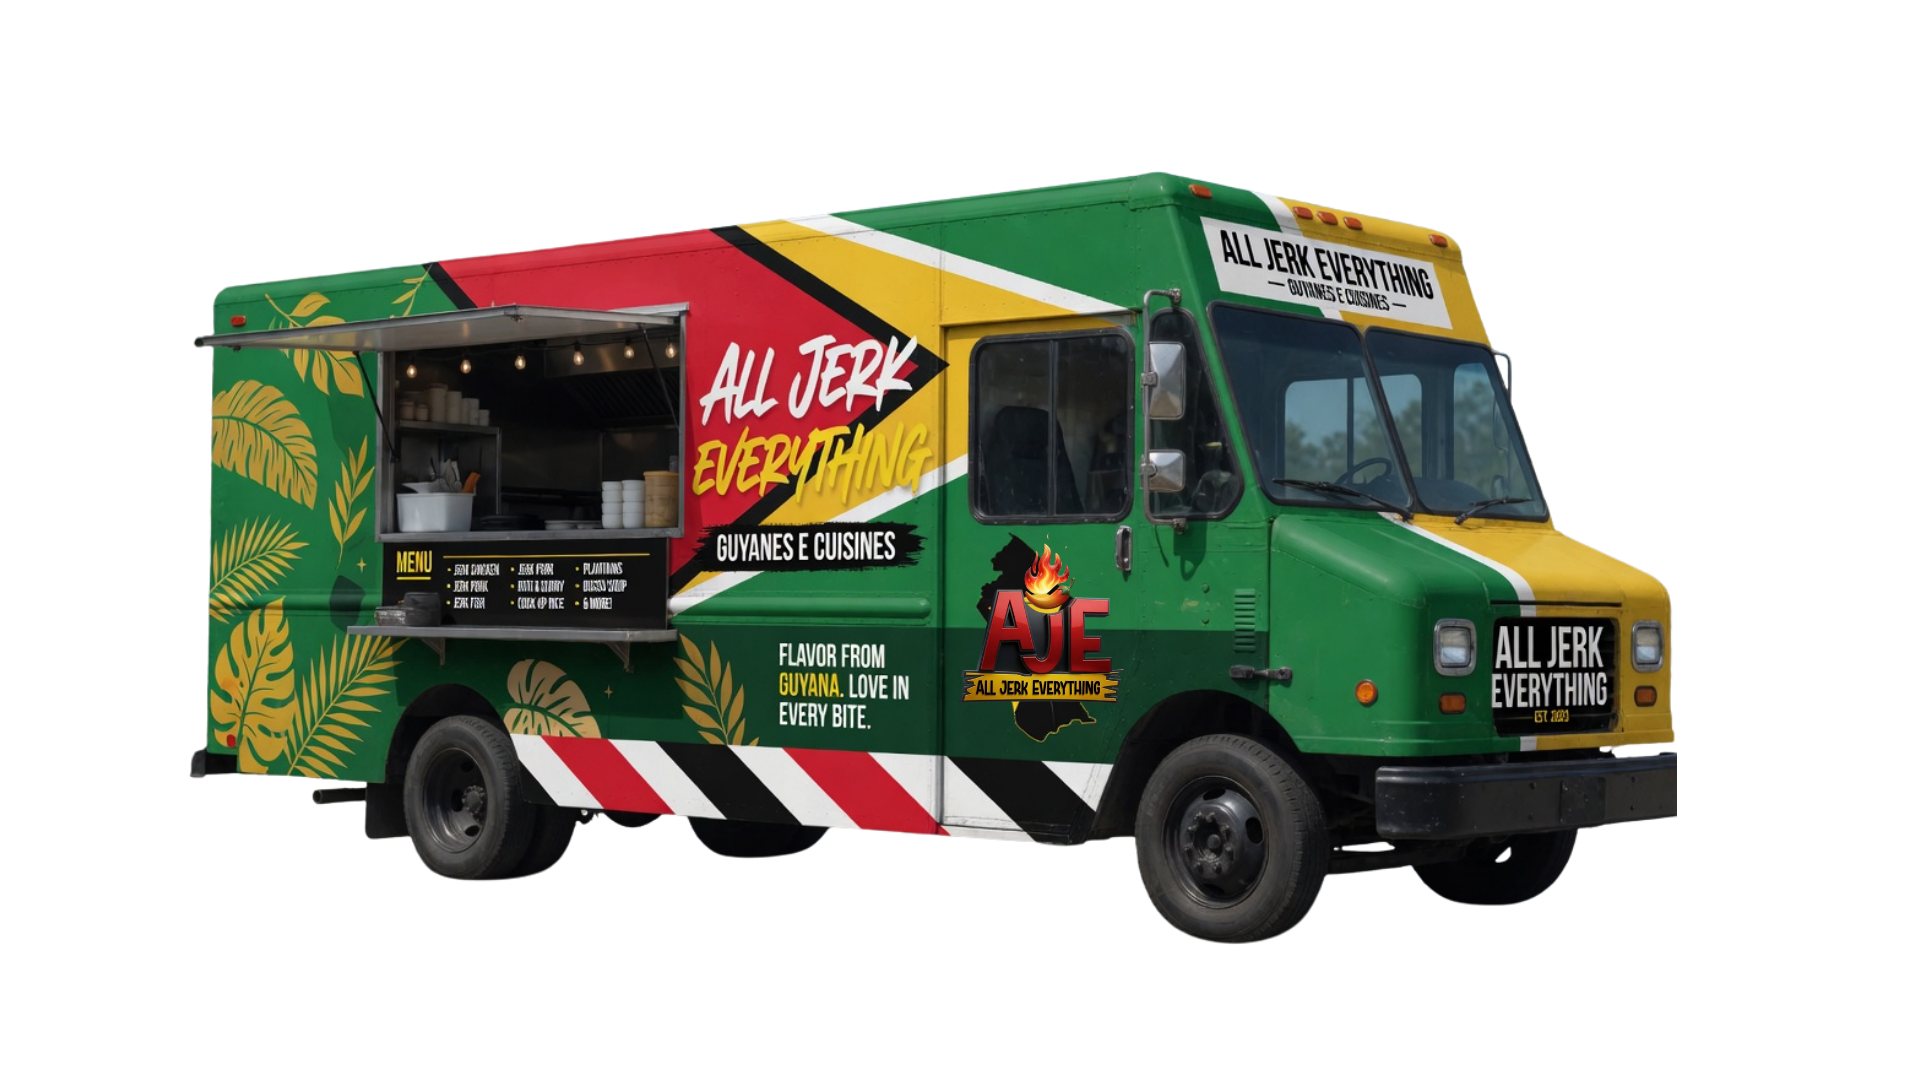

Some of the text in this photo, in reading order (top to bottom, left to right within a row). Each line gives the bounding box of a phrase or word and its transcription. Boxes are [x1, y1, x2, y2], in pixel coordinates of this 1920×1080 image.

[1220, 229, 1434, 300] ALL JERK EVERYTHING
[699, 334, 918, 426] ALL JERK
[691, 421, 933, 504] EVERYTHING
[396, 550, 433, 573] MENU
[716, 530, 896, 563] GUYANES E CUISINES
[978, 589, 1112, 674] AJE
[1495, 625, 1604, 669] ALL JERK
[779, 642, 885, 669] FLAVOR FROM
[779, 672, 909, 700] GUYANA. LOVE IN
[975, 679, 1101, 696] ALL JERK EVERYTHING
[1491, 671, 1607, 709] EVERYTHING
[779, 701, 872, 730] EVERY BITE.
